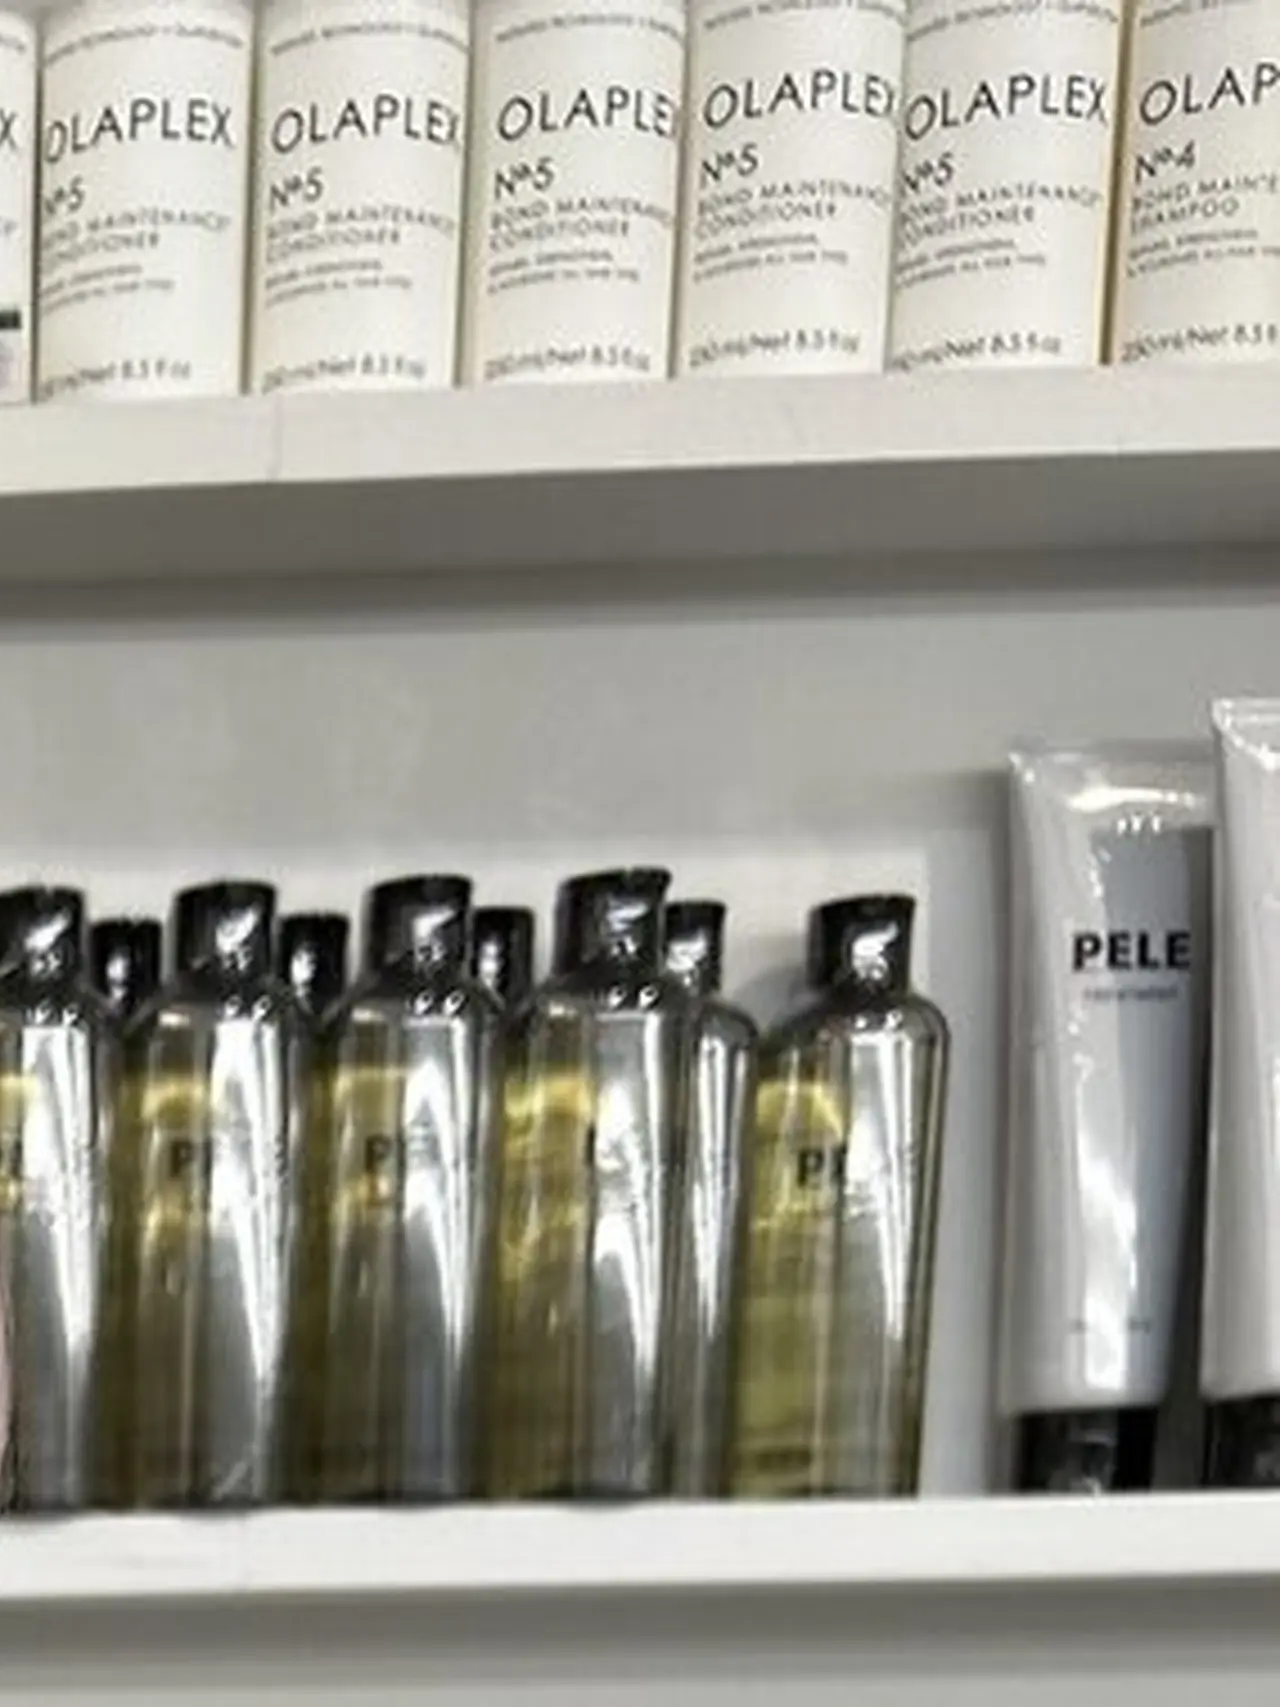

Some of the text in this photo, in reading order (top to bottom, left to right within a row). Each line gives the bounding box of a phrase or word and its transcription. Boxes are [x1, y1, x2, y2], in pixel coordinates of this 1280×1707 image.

[43, 97, 236, 165] OLAPLEX
[497, 84, 678, 142] OLAPLE
[904, 73, 1110, 142] OLAPLEX
[1072, 927, 1193, 973] PELE
